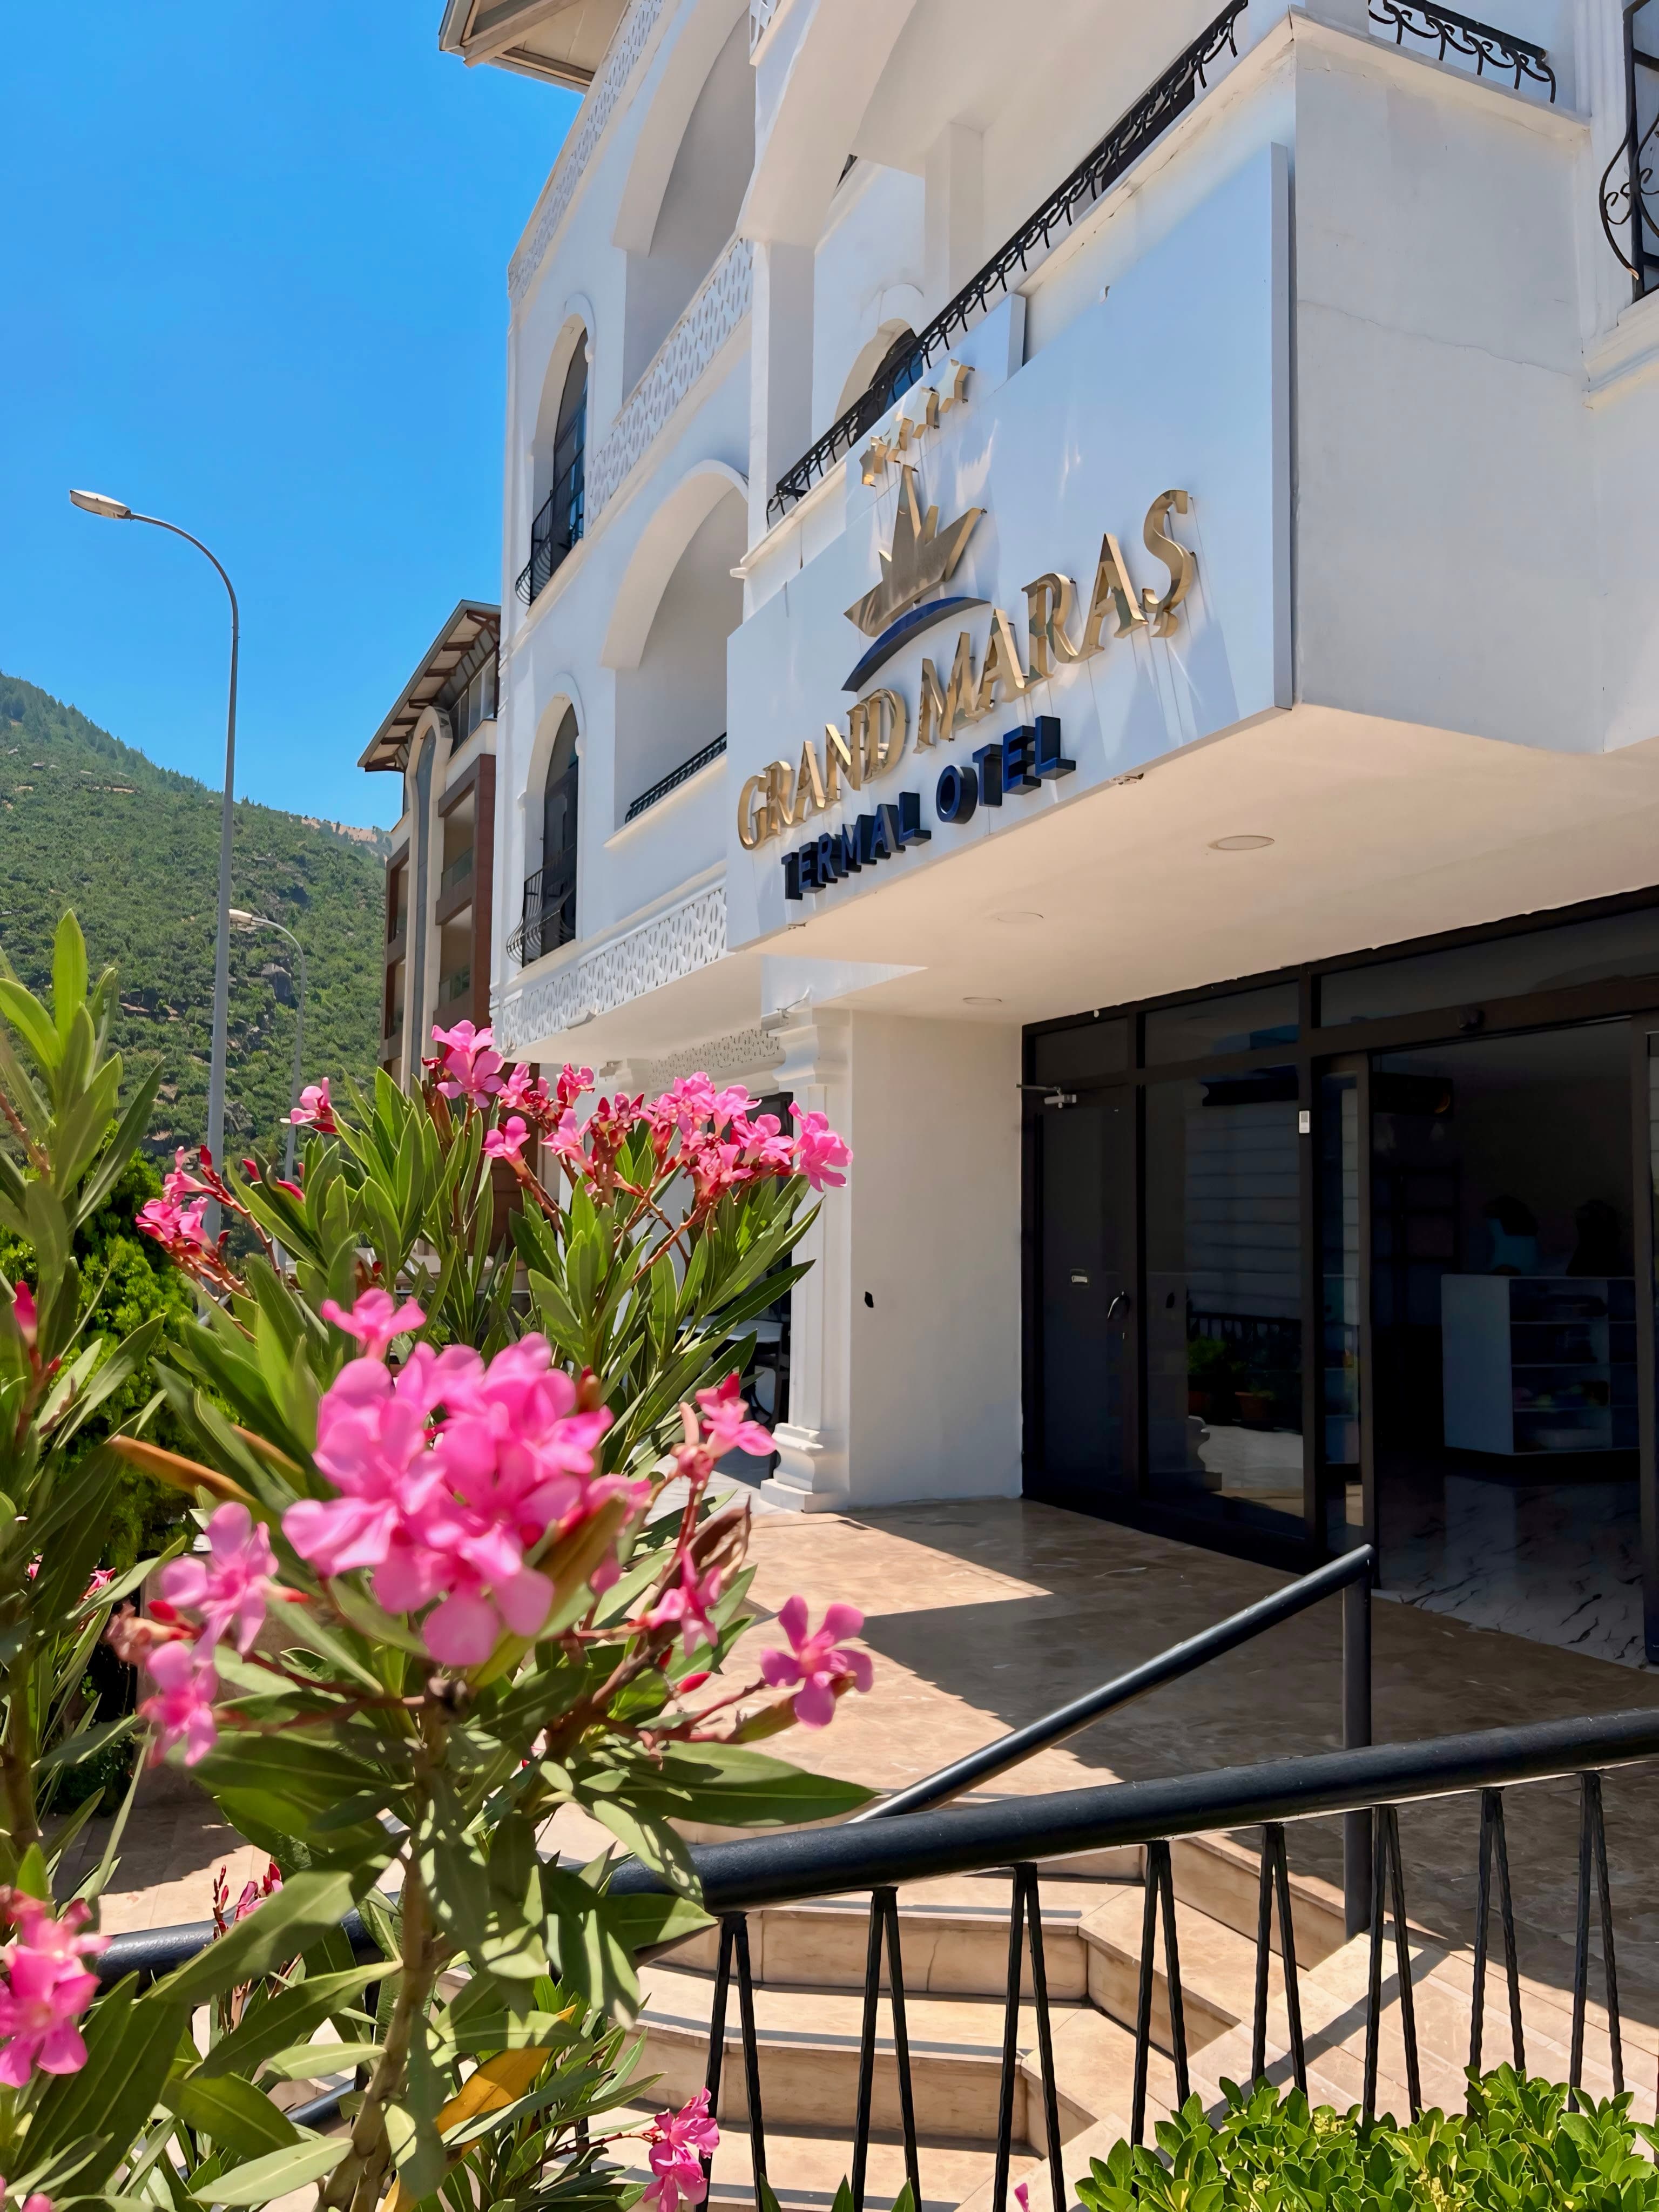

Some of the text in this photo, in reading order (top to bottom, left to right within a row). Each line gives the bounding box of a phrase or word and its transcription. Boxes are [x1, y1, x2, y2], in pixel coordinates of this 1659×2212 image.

[737, 688, 908, 851] GRAND
[781, 715, 1076, 900] TERMAL OTEL
